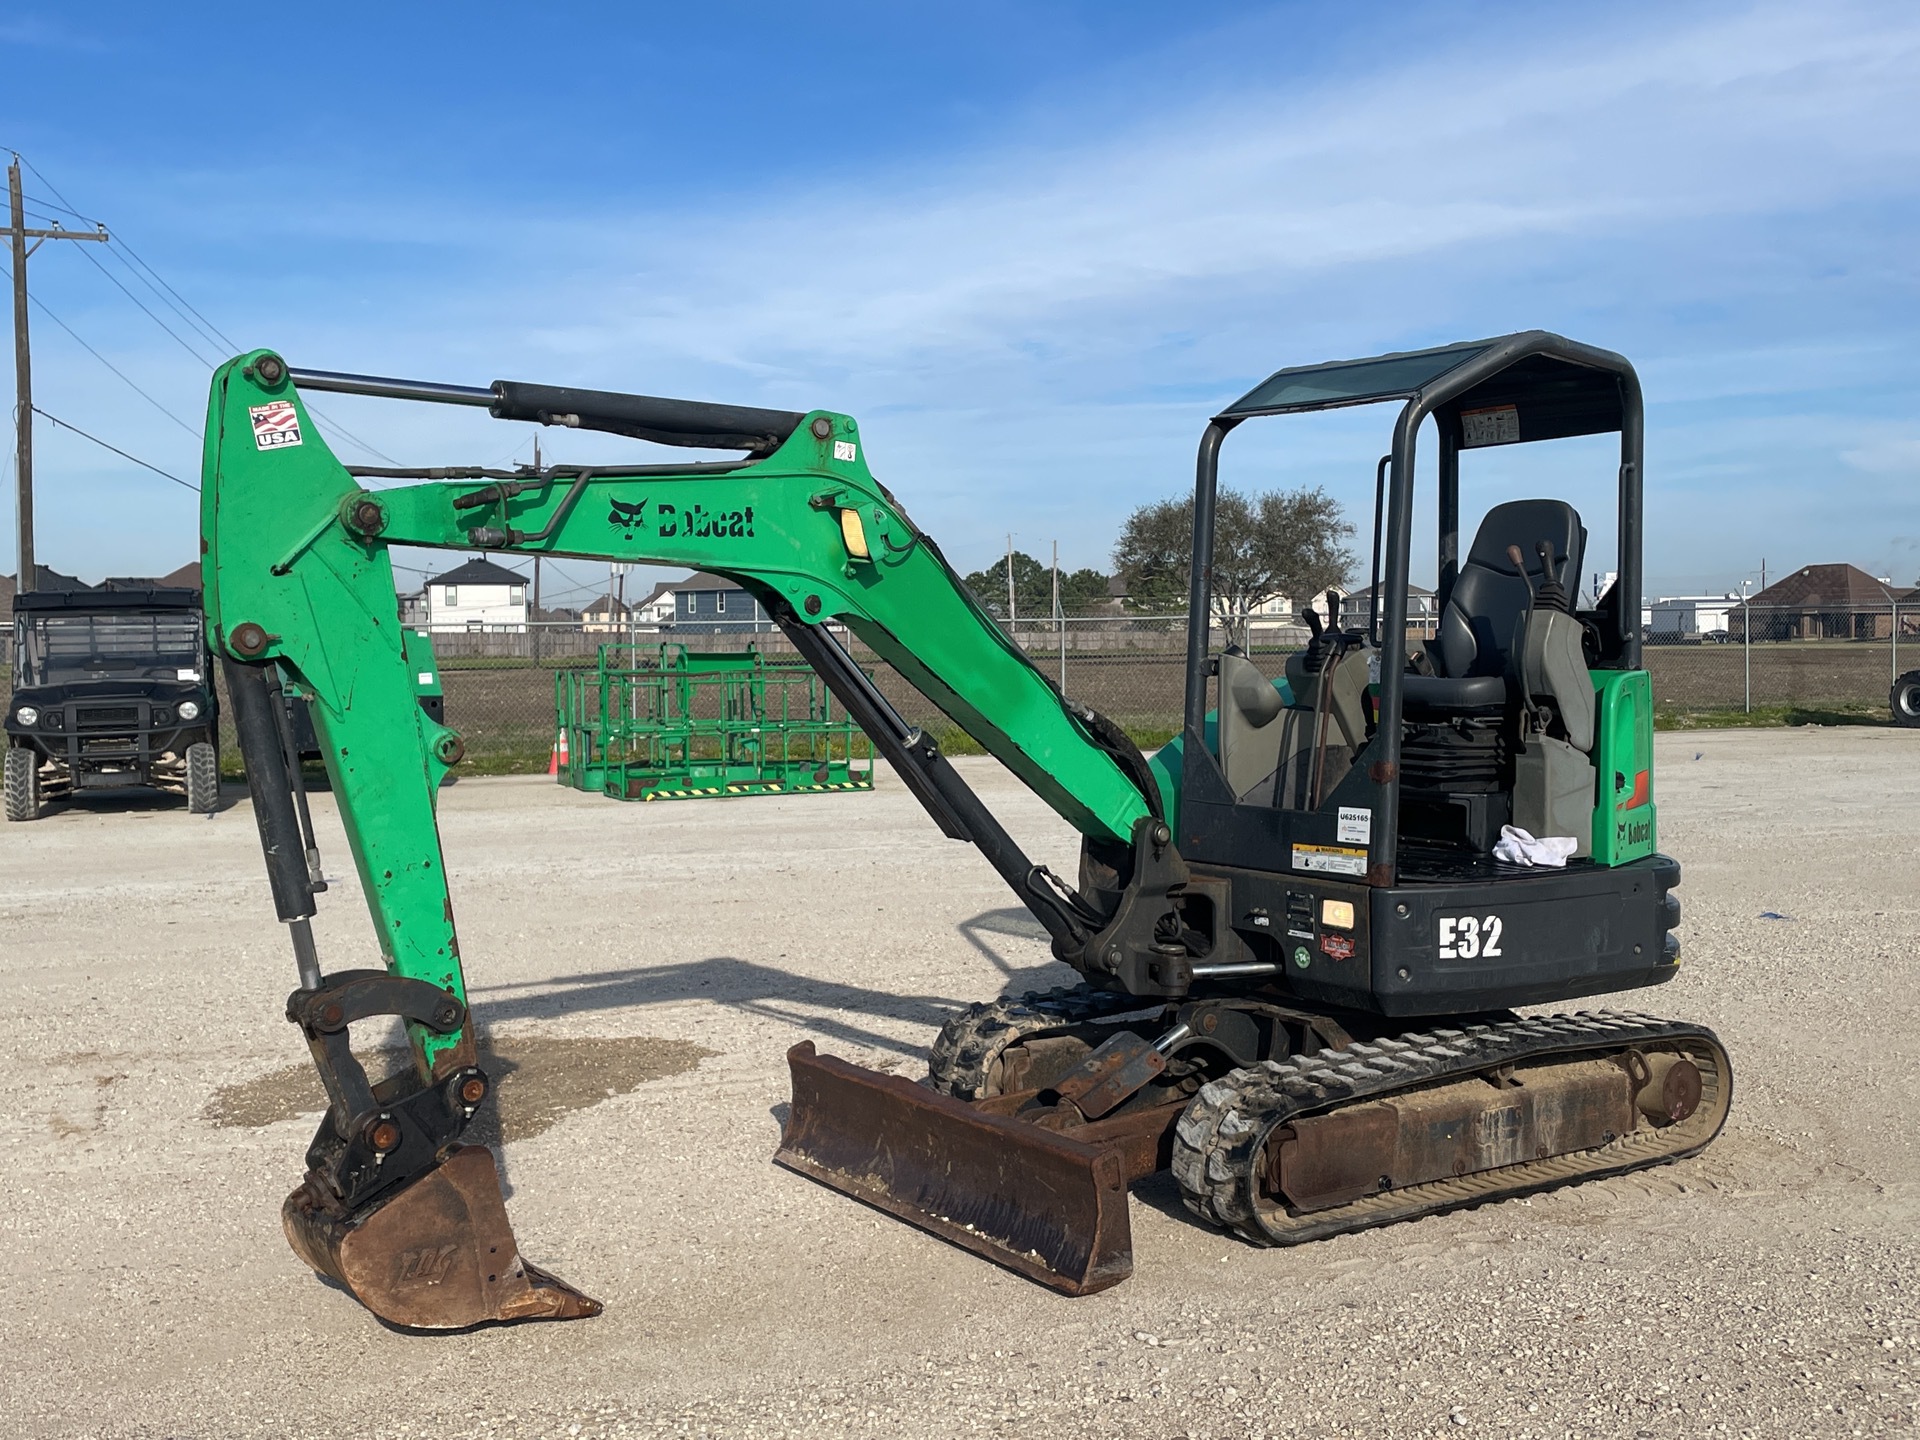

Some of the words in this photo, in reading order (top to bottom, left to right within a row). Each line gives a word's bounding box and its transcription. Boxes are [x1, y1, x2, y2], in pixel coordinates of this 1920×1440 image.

[258, 430, 298, 446] USA
[1628, 819, 1651, 846] Bobcat
[1439, 915, 1503, 959] E32
